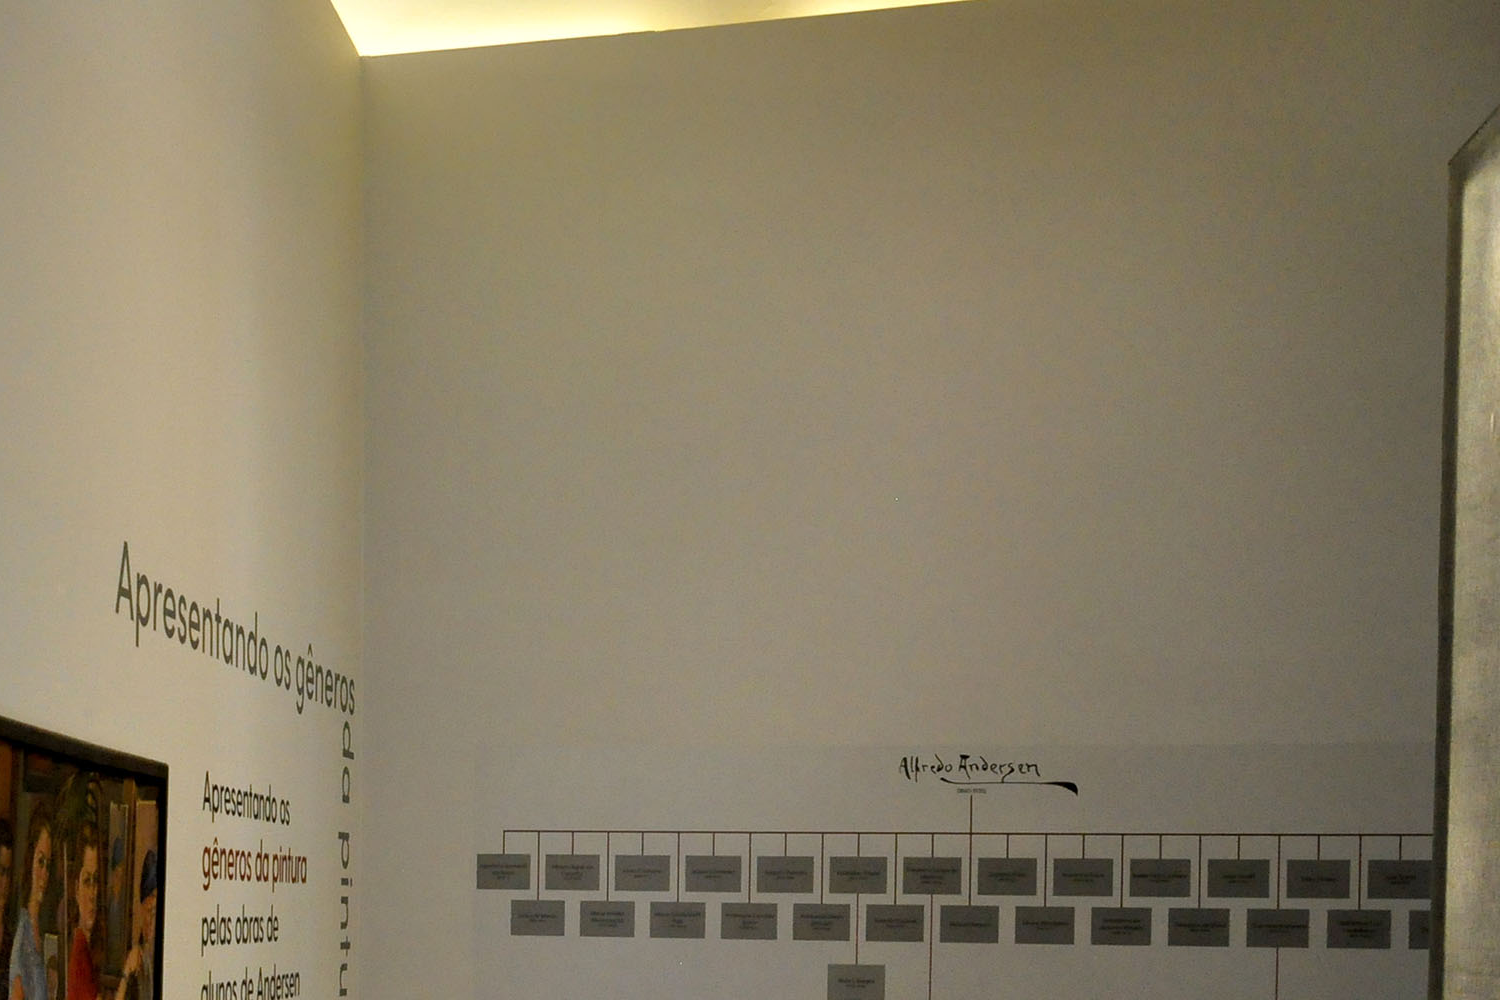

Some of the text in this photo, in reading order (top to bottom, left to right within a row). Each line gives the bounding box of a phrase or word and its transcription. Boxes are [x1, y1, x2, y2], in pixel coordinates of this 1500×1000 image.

[115, 541, 356, 715] Apresentando os gêneros
[341, 720, 355, 804] da
[898, 754, 1041, 783] Alfredo Andersen
[202, 770, 291, 826] Apresentando os
[202, 837, 307, 893] gêneros da pintura
[201, 904, 279, 957] pelas obras de
